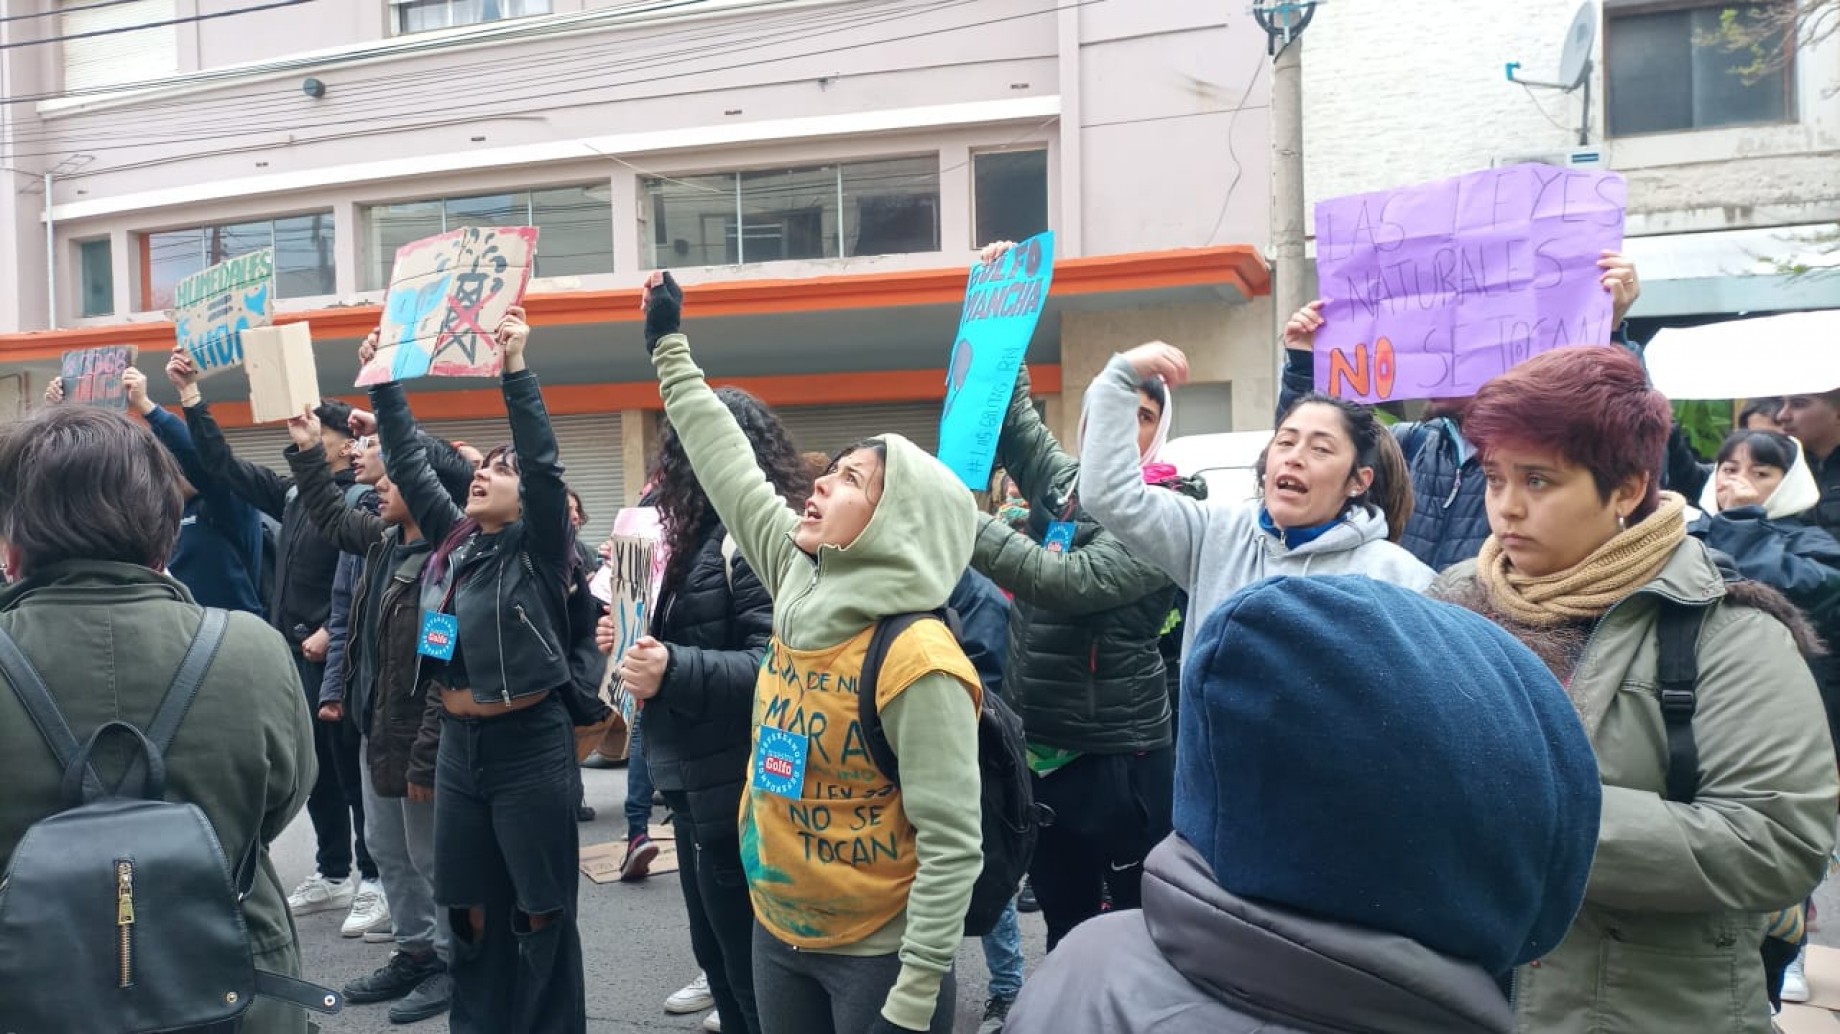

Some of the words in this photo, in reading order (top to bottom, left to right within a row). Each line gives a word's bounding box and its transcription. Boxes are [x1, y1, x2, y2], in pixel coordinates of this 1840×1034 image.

[1327, 193, 1408, 263] LAS
[175, 251, 272, 308] HUMEDALES
[1346, 238, 1564, 322] NATURALES
[1328, 336, 1396, 399] NO
[1417, 323, 1473, 389] SE
[807, 671, 831, 692] DE
[763, 695, 831, 765] MAR
[765, 757, 793, 776] Golfo
[788, 804, 831, 832] NO
[849, 804, 885, 831] SE
[797, 831, 898, 867] TOCAN
